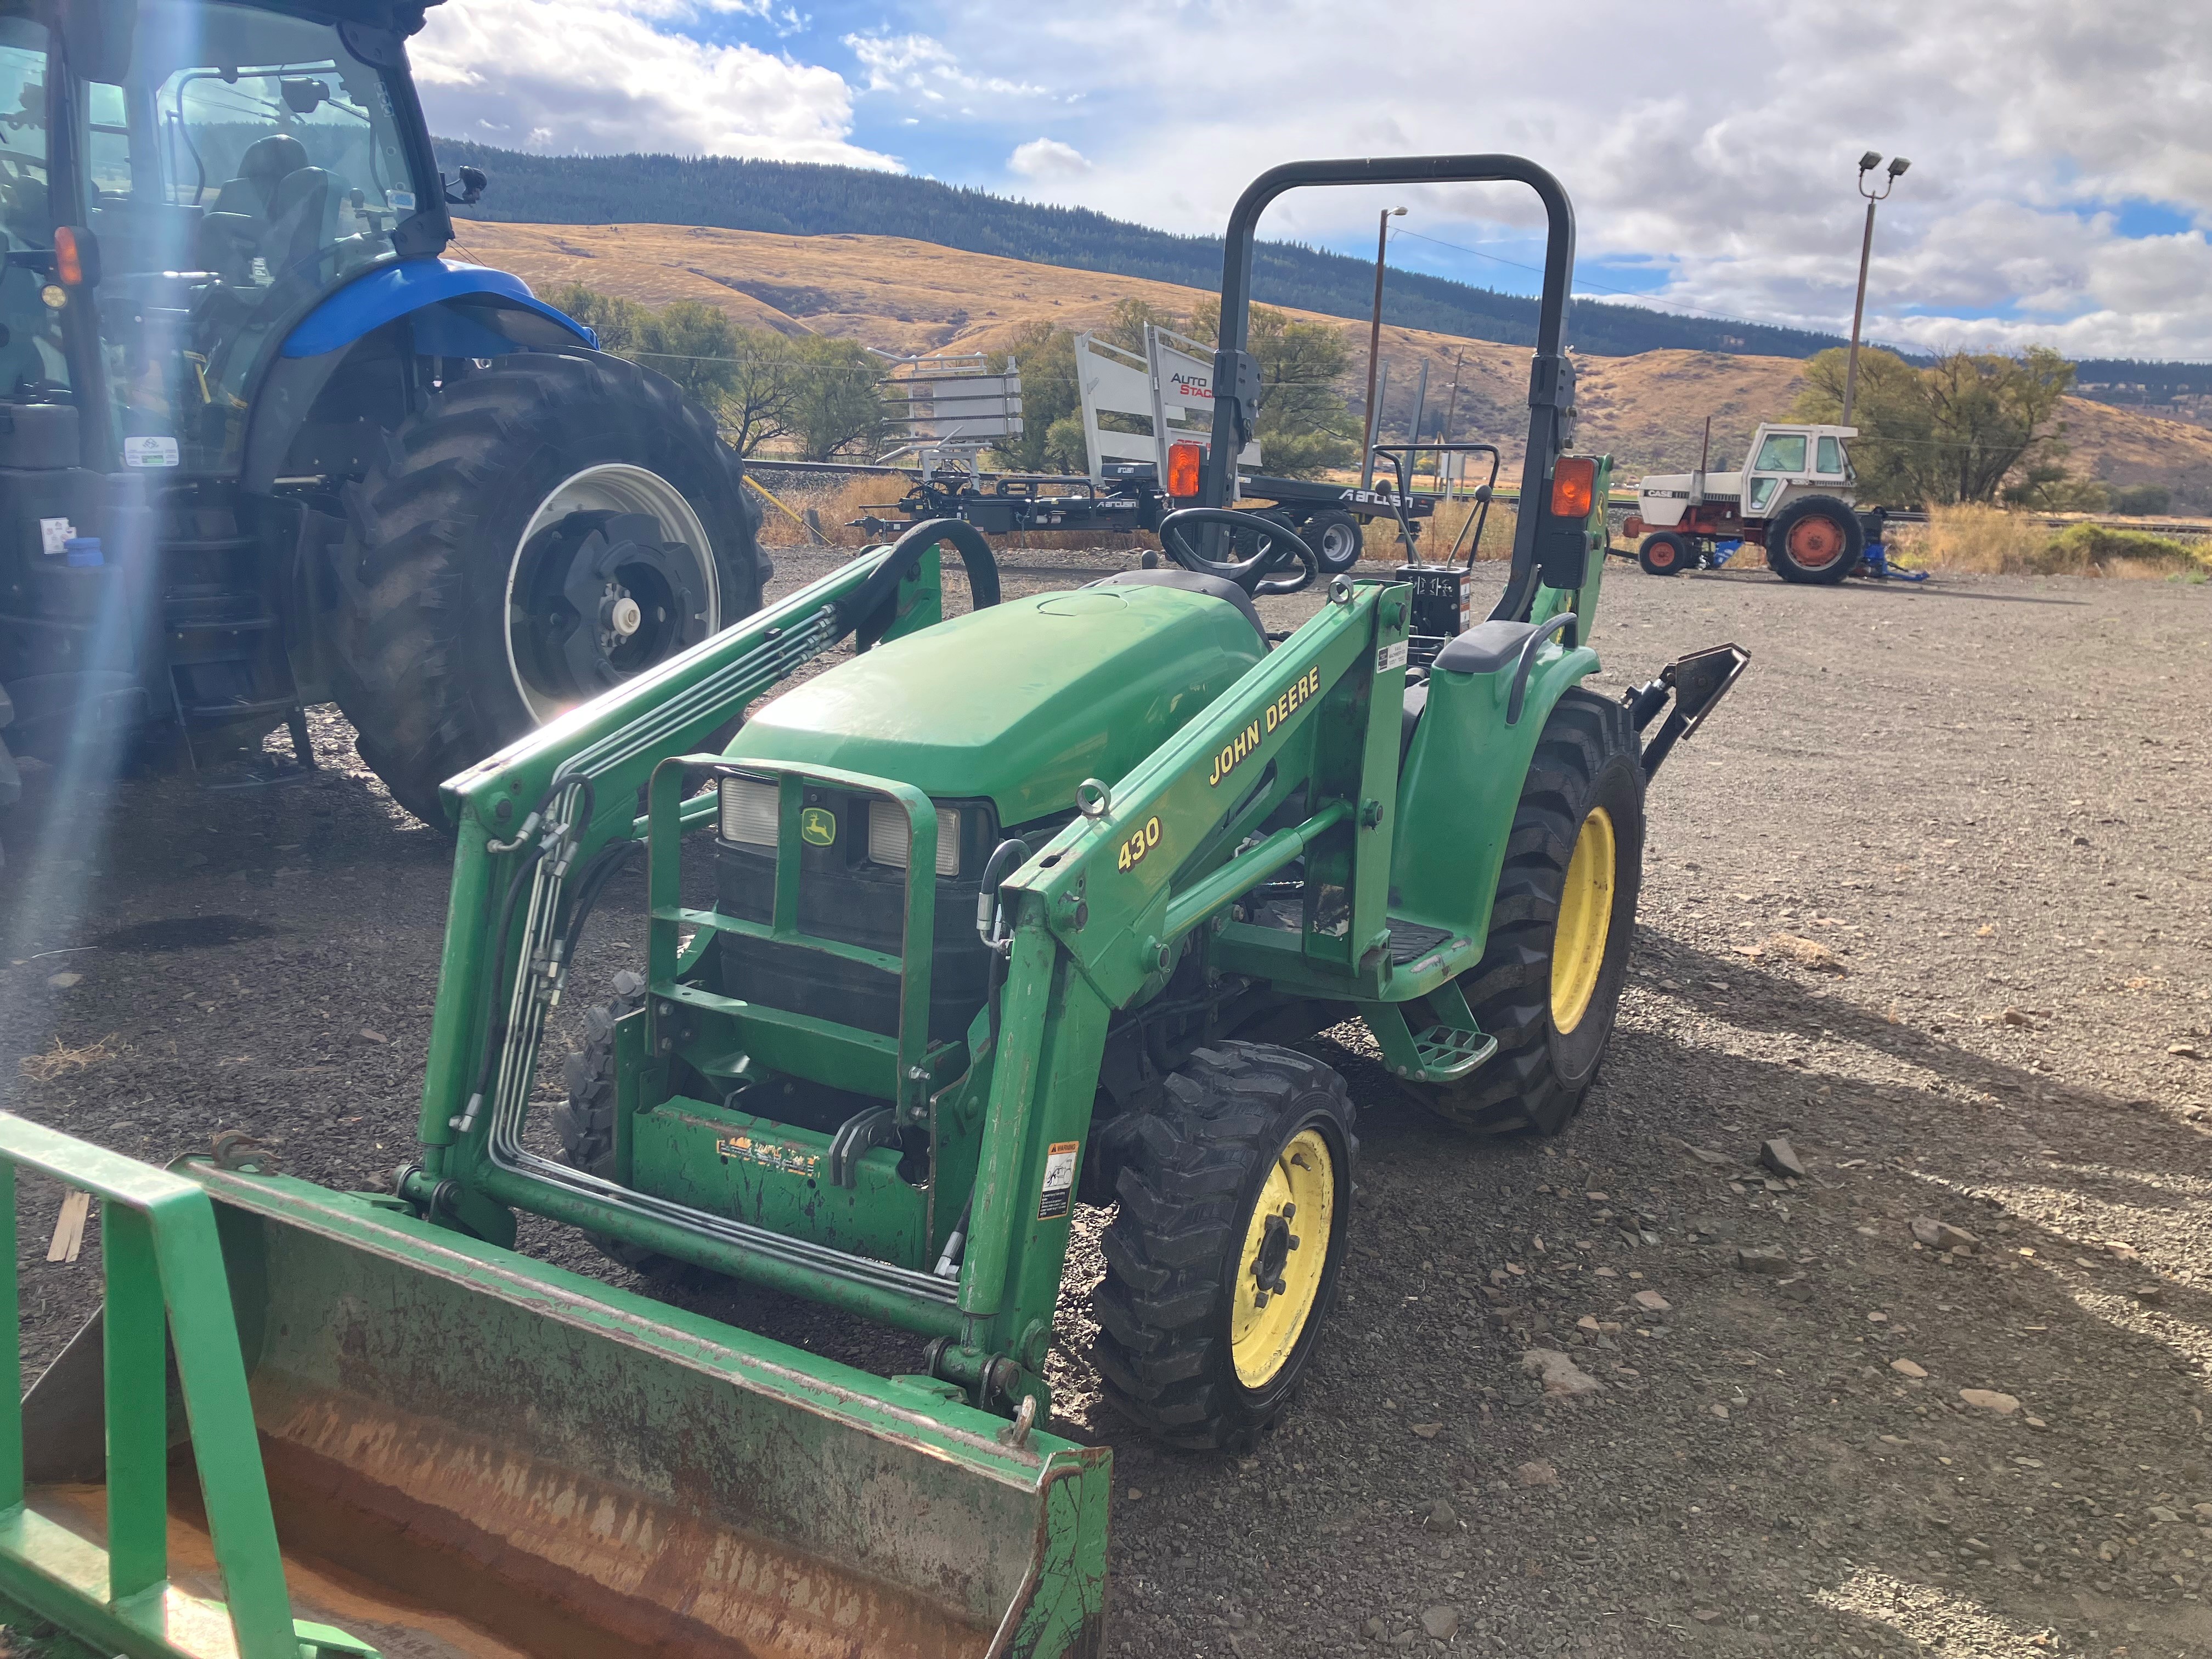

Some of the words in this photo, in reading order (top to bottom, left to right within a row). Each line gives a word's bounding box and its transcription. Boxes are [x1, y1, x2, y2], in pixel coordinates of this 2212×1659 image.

[1171, 373, 1207, 387] AUTO
[1180, 384, 1214, 399] STAC
[1356, 490, 1414, 509] arcusn
[1648, 490, 1673, 498] CASE
[1209, 718, 1261, 788] JOHN
[1266, 665, 1320, 735] DEERE
[1118, 816, 1162, 873] 430
